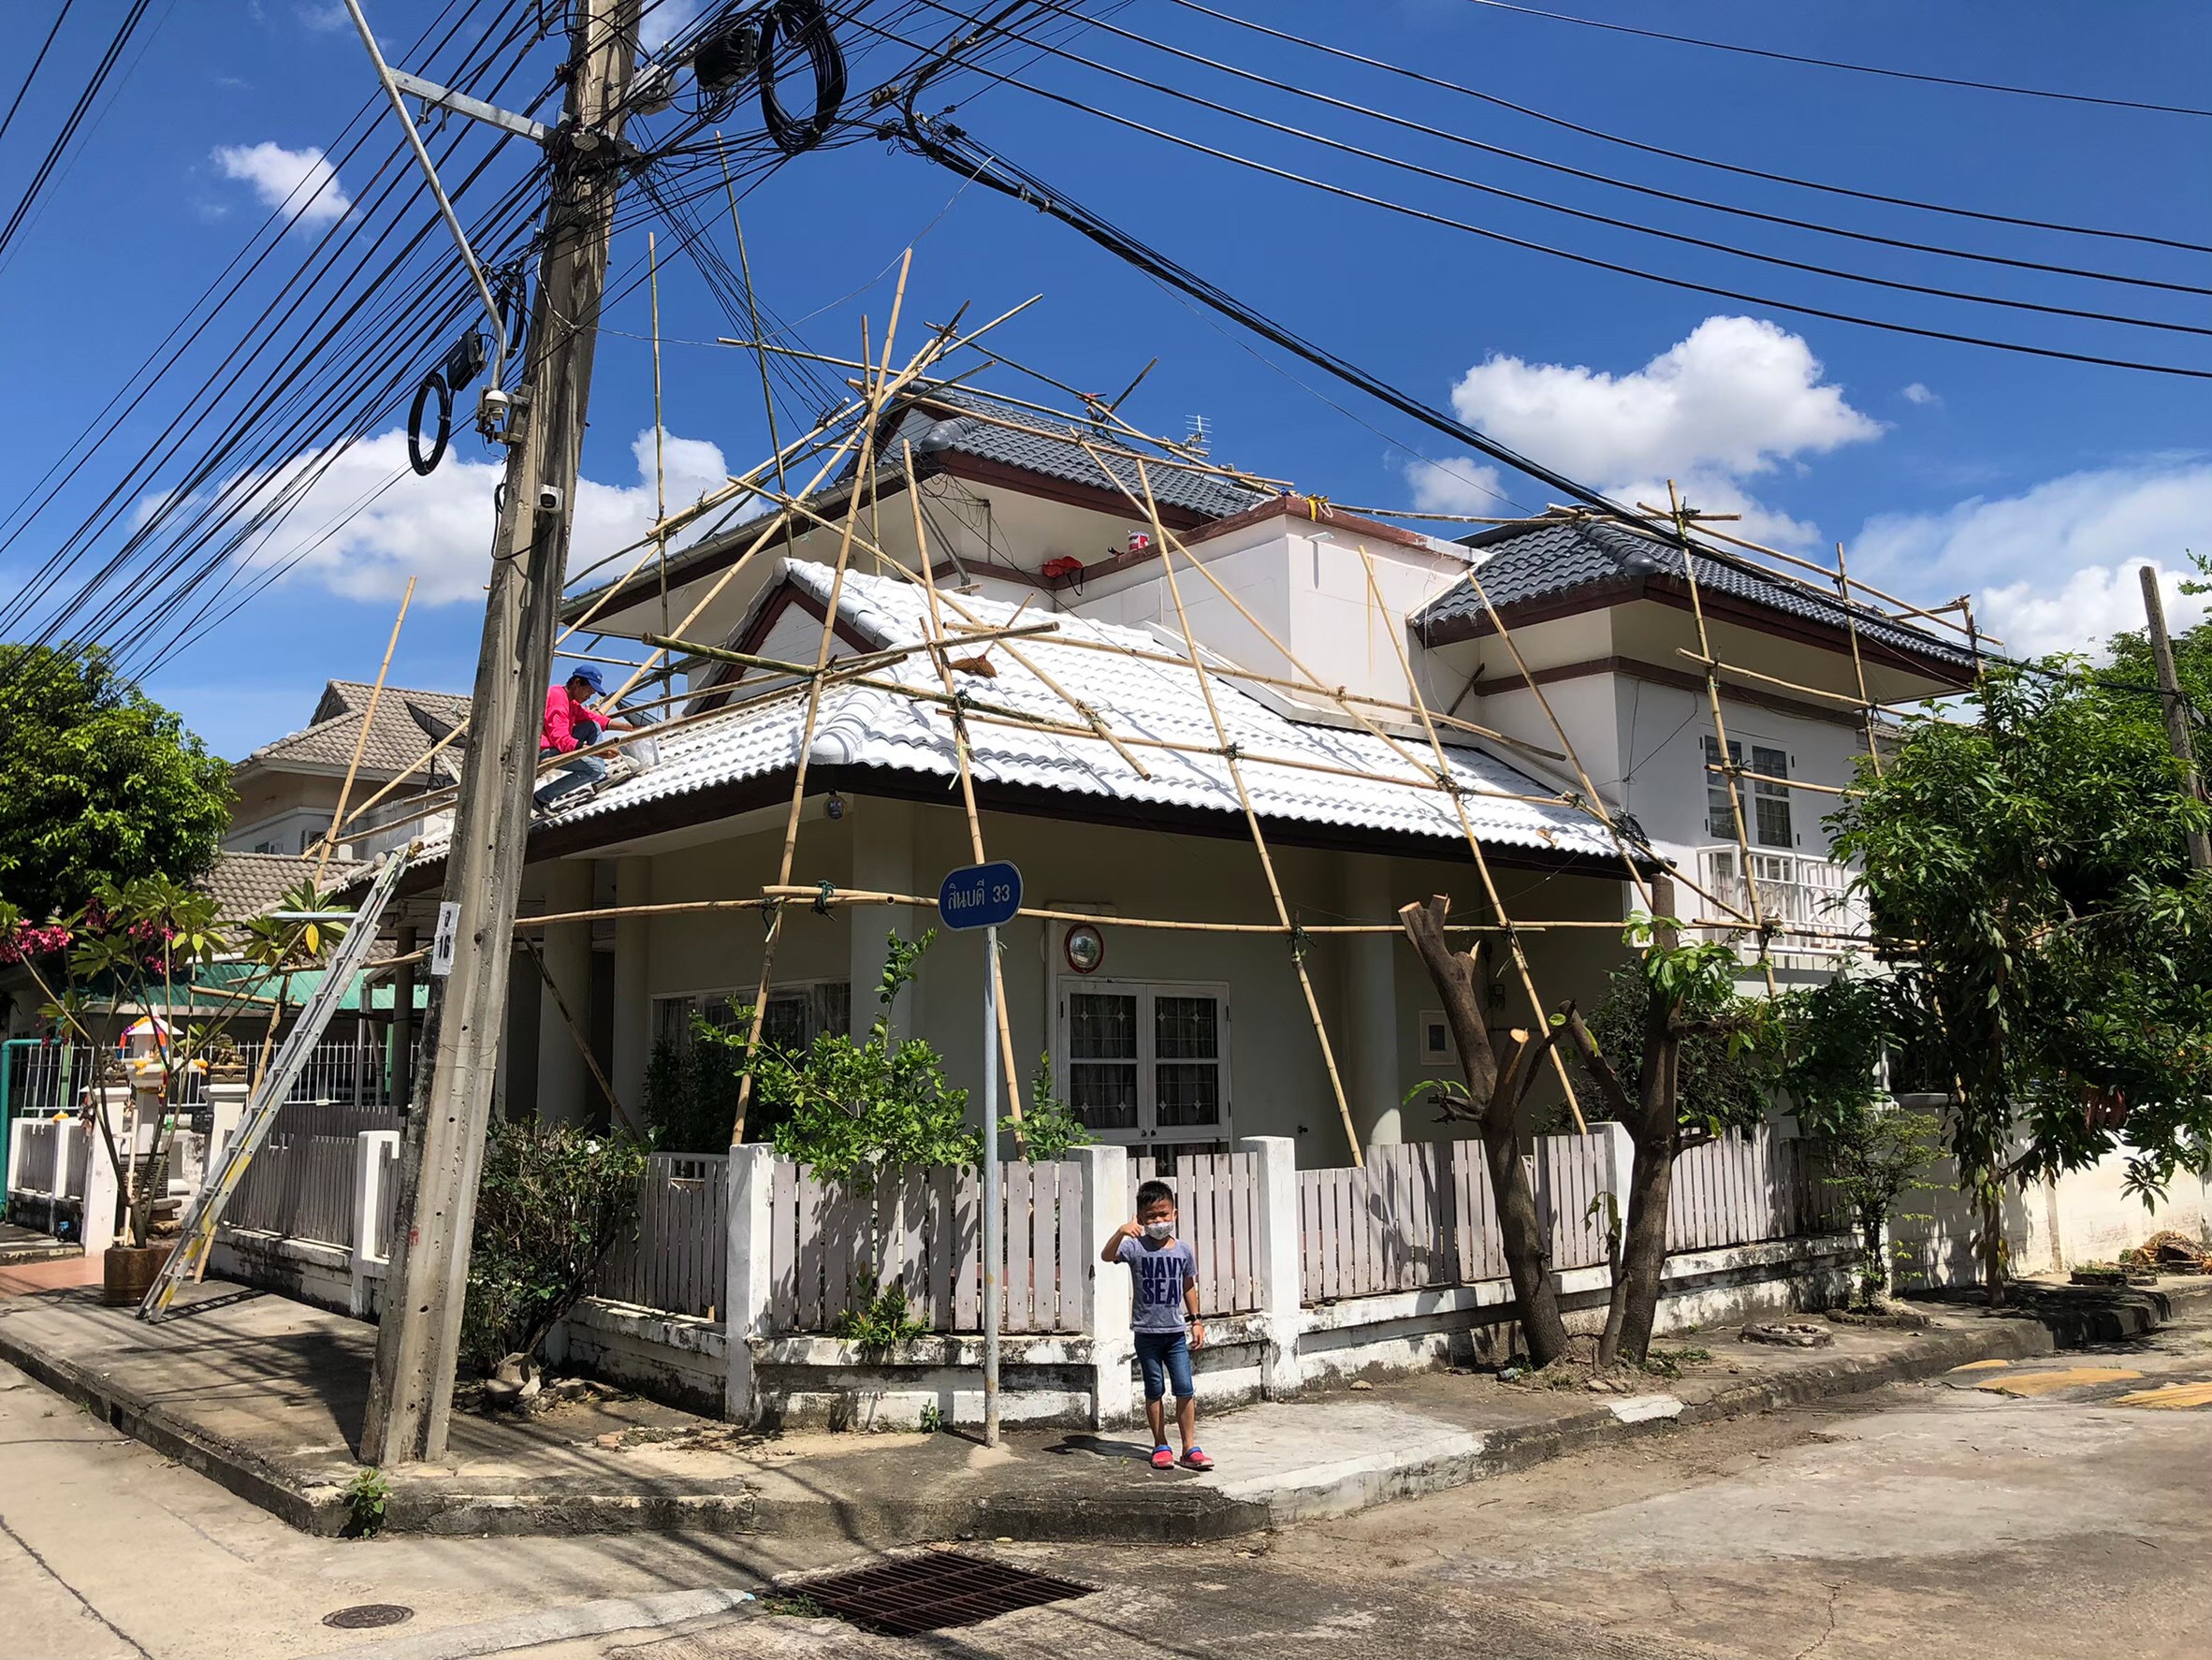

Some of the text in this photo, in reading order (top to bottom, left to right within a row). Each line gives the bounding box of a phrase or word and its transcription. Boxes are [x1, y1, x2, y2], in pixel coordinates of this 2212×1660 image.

[948, 878, 1011, 910] สินบดี 33
[438, 935, 451, 959] 16
[1142, 1257, 1186, 1278] NAVY
